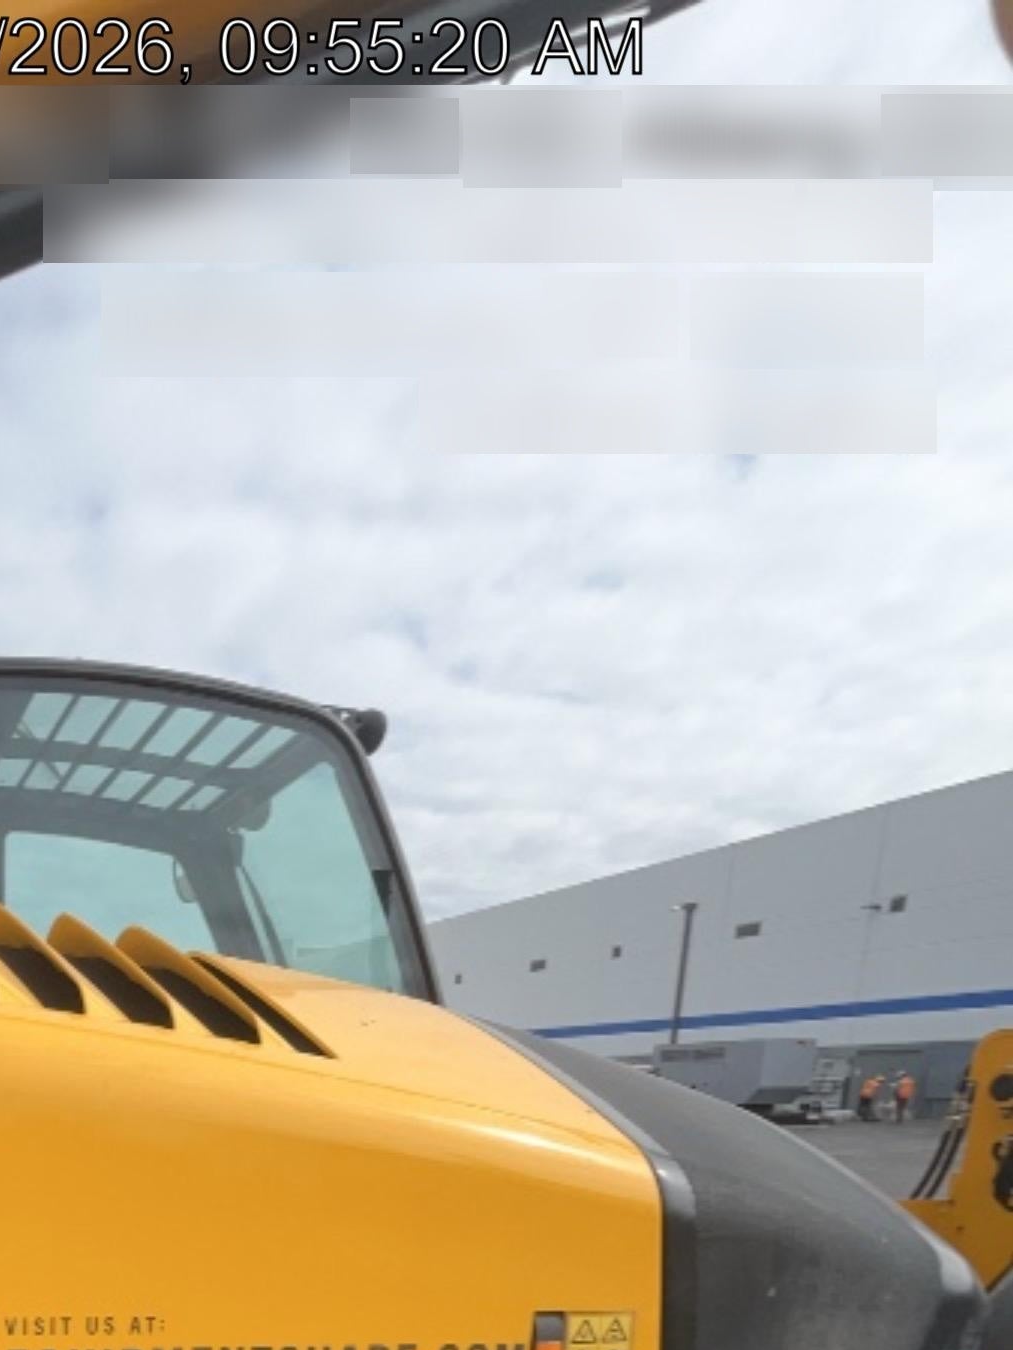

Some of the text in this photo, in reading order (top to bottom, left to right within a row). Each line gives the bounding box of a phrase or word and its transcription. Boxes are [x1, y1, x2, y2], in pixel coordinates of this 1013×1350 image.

[4, 1316, 166, 1336] VISIT US AT:
